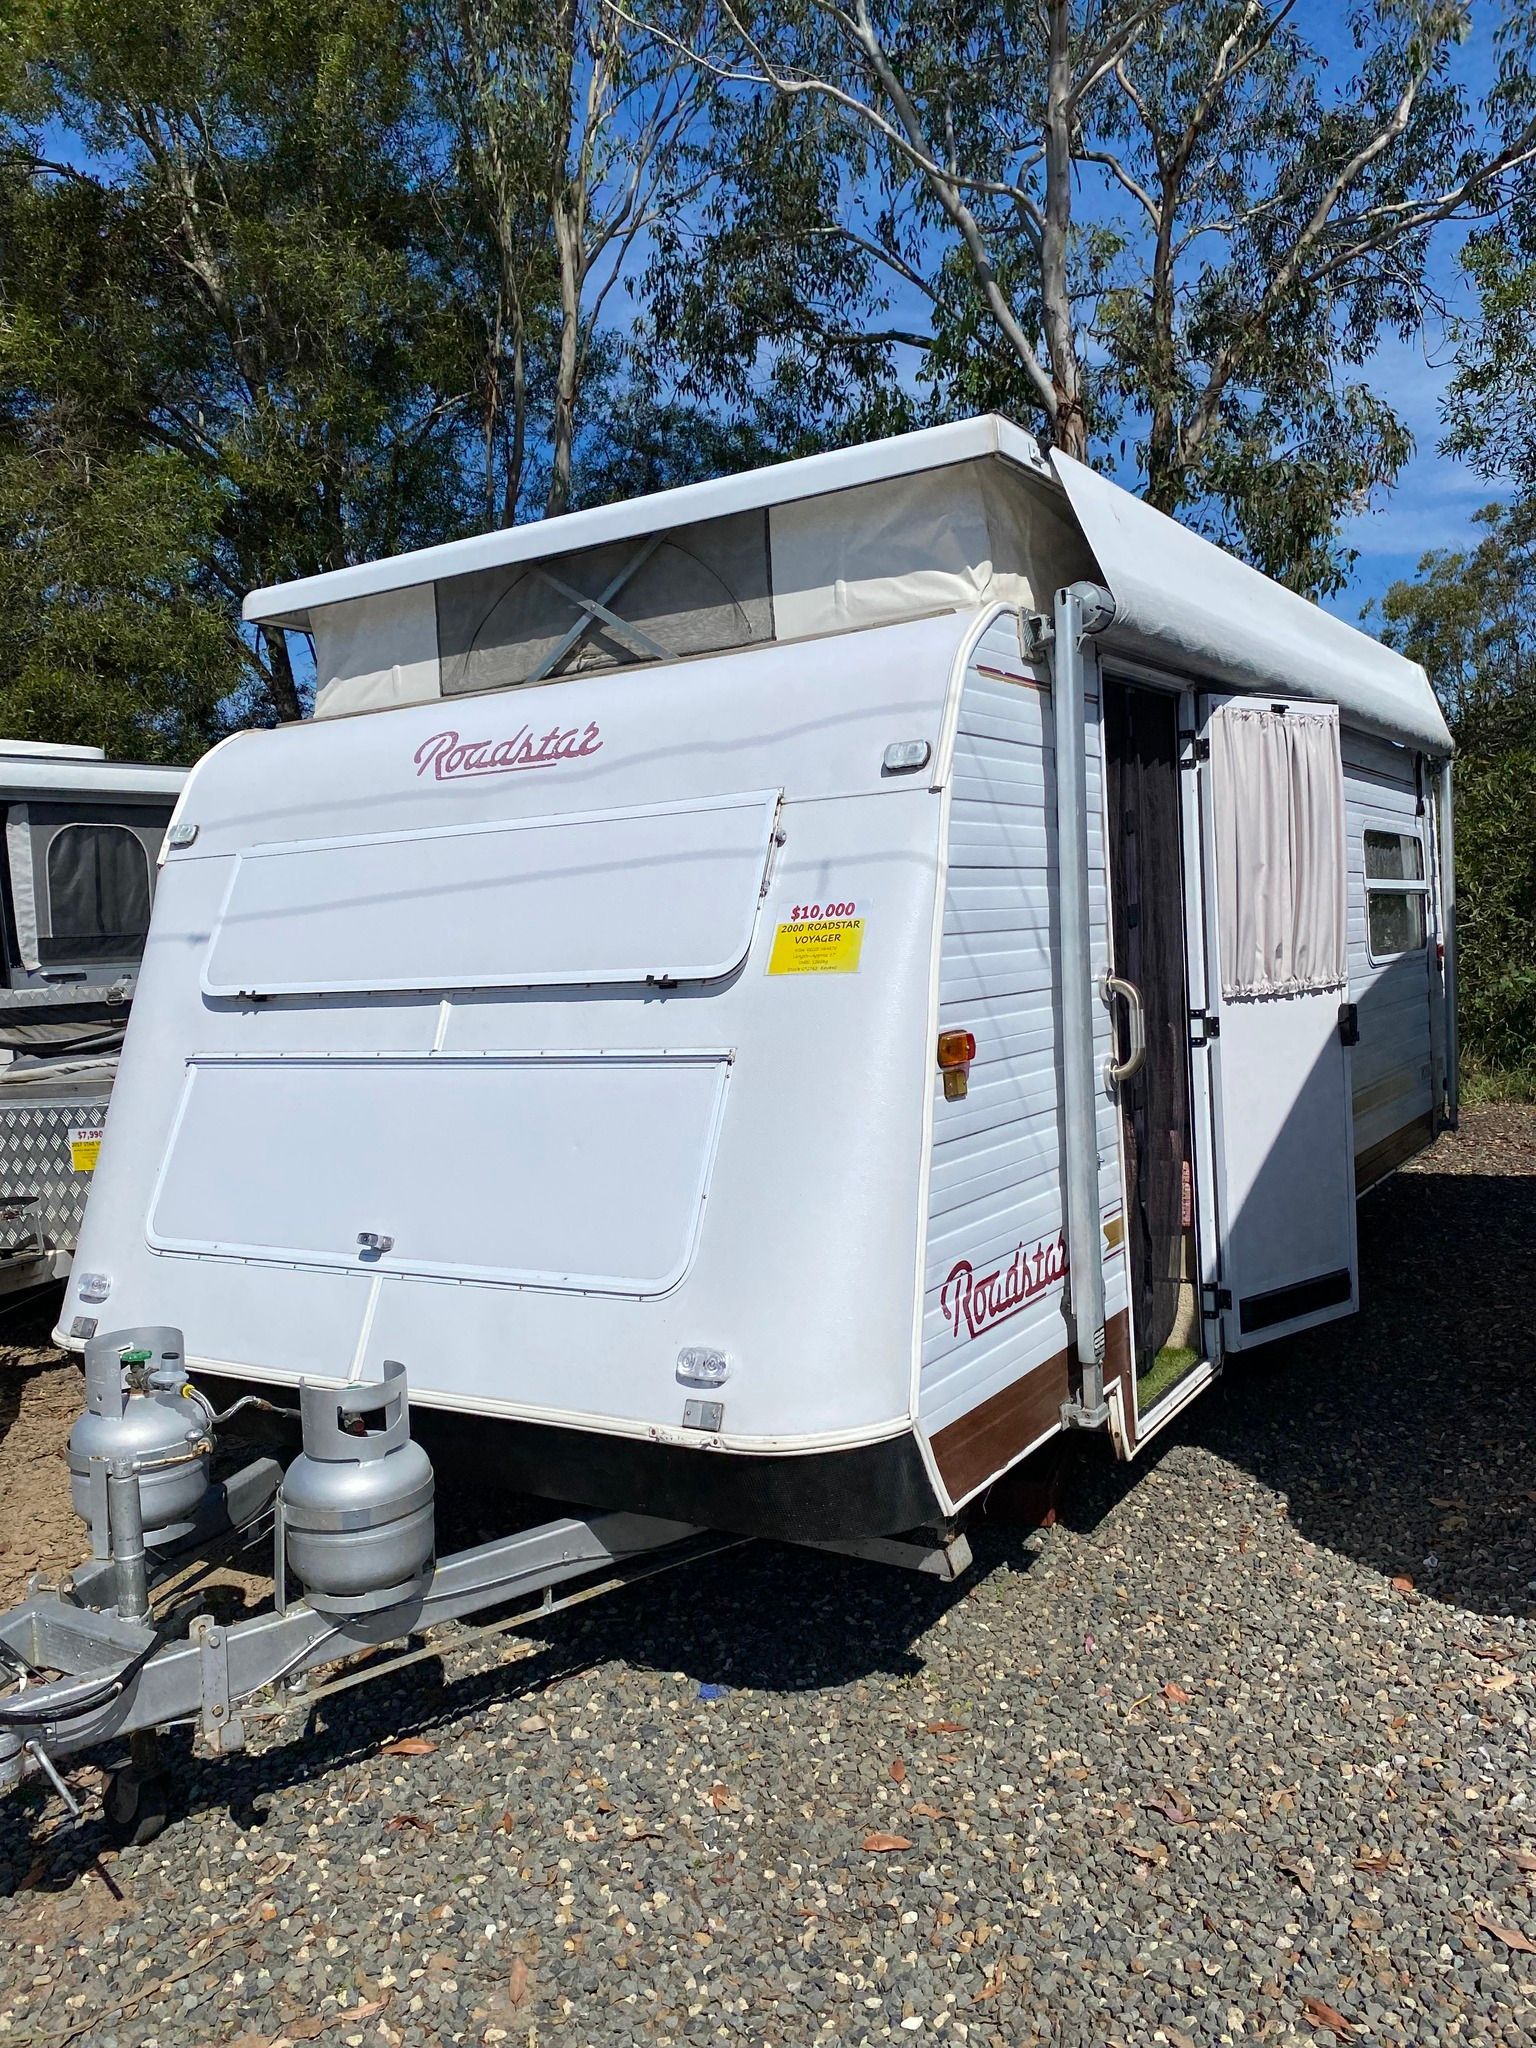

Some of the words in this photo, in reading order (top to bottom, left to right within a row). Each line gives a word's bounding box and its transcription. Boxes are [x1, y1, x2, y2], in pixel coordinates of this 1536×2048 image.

[414, 721, 604, 780] Roadstar
[791, 902, 856, 922] $10,000
[781, 924, 805, 934] 2000
[807, 920, 860, 932] ROADSTAR
[794, 933, 841, 945] VOYAGER
